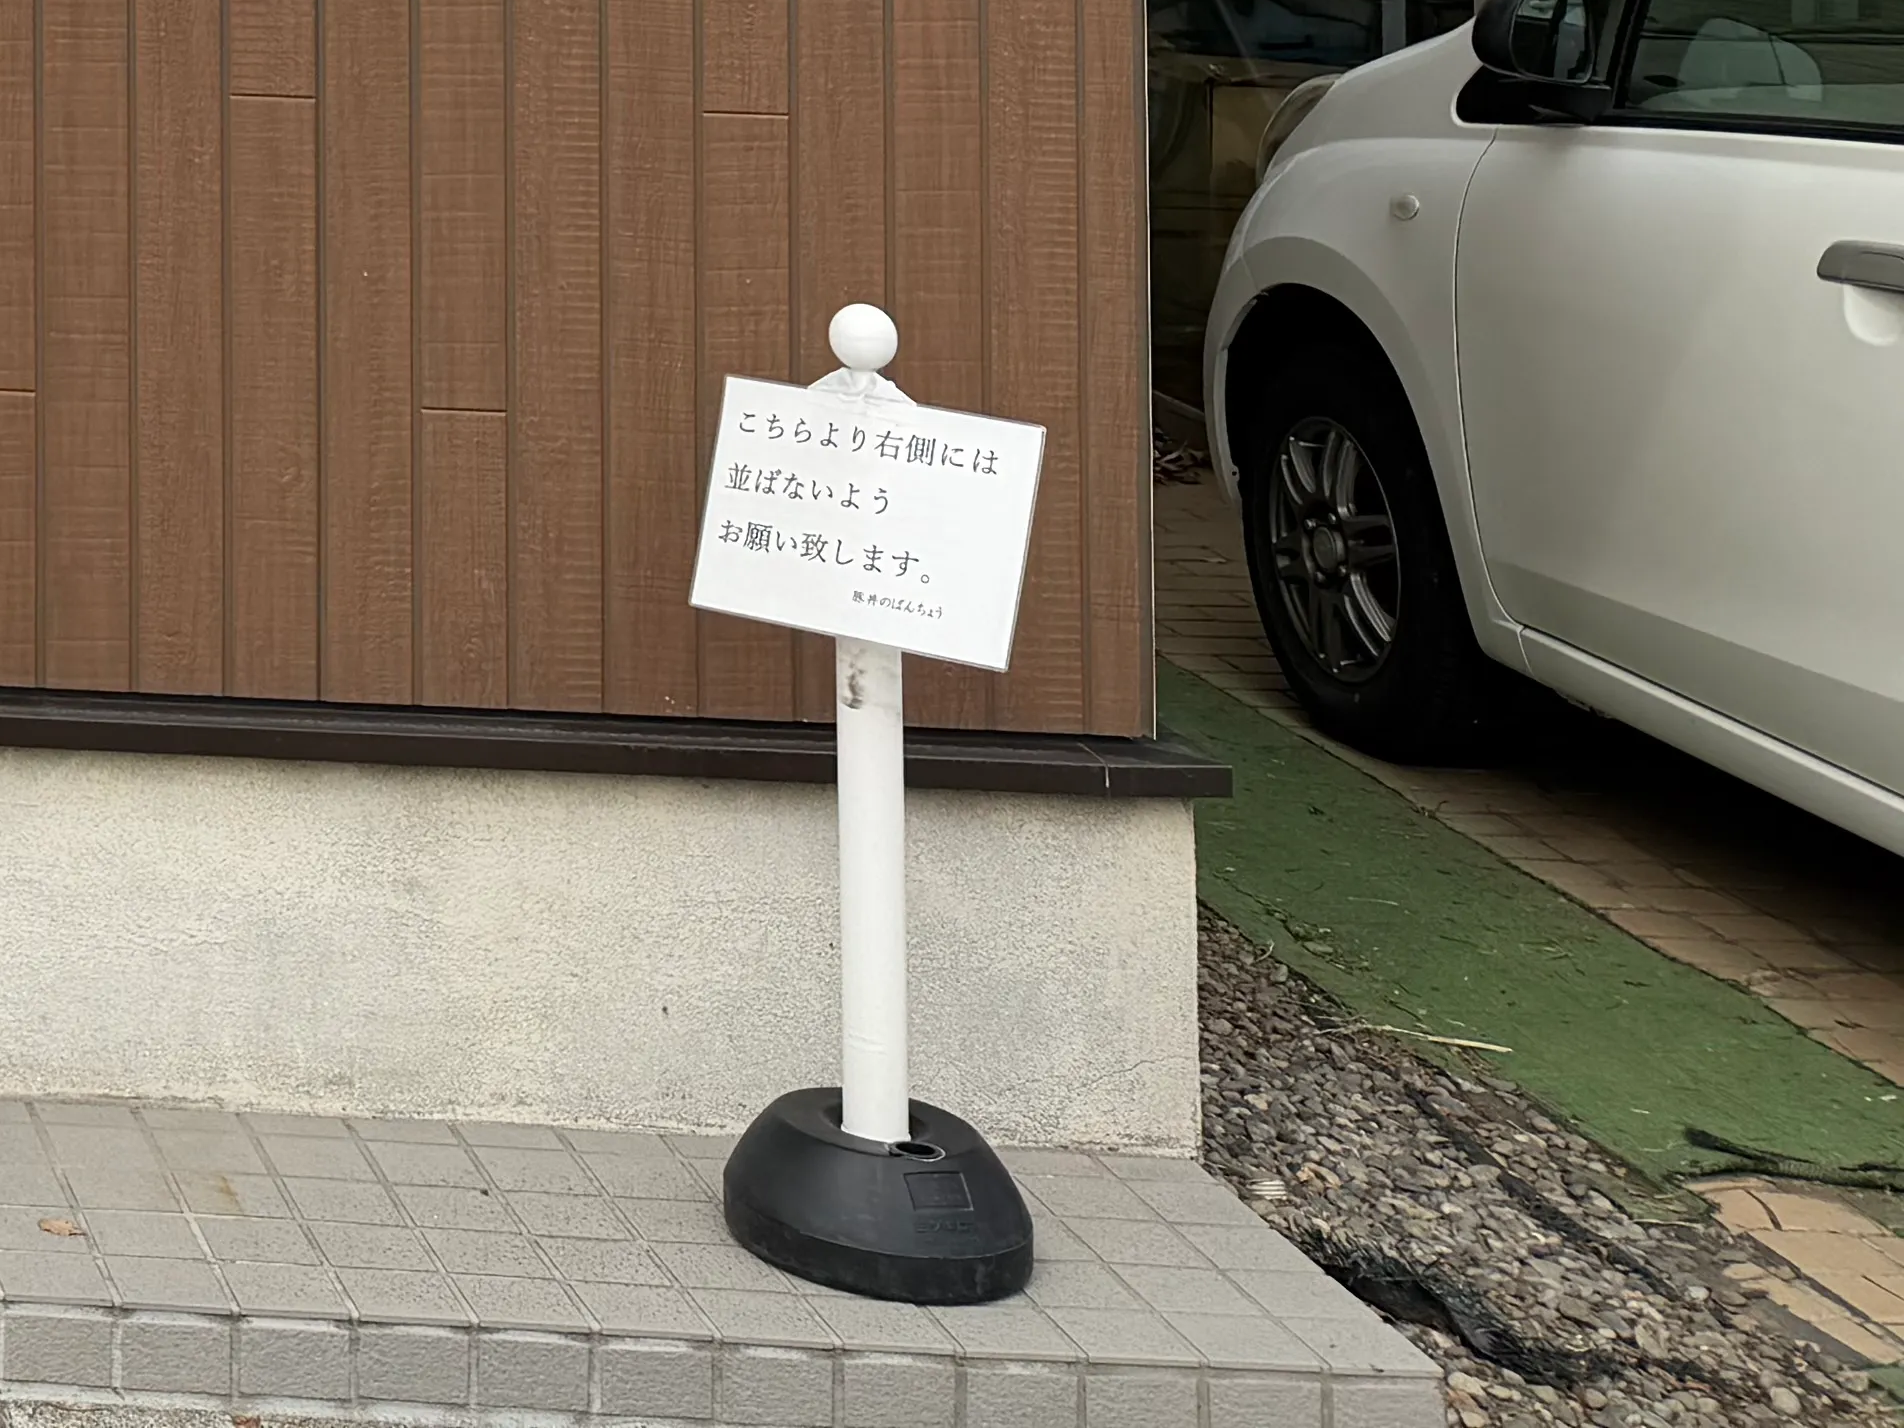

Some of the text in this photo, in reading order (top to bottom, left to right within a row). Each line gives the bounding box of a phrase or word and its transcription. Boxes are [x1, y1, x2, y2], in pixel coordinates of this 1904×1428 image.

[739, 412, 999, 475] こちらより右側には
[724, 462, 888, 514] 並ばないよう
[718, 520, 930, 585] お願い致します。
